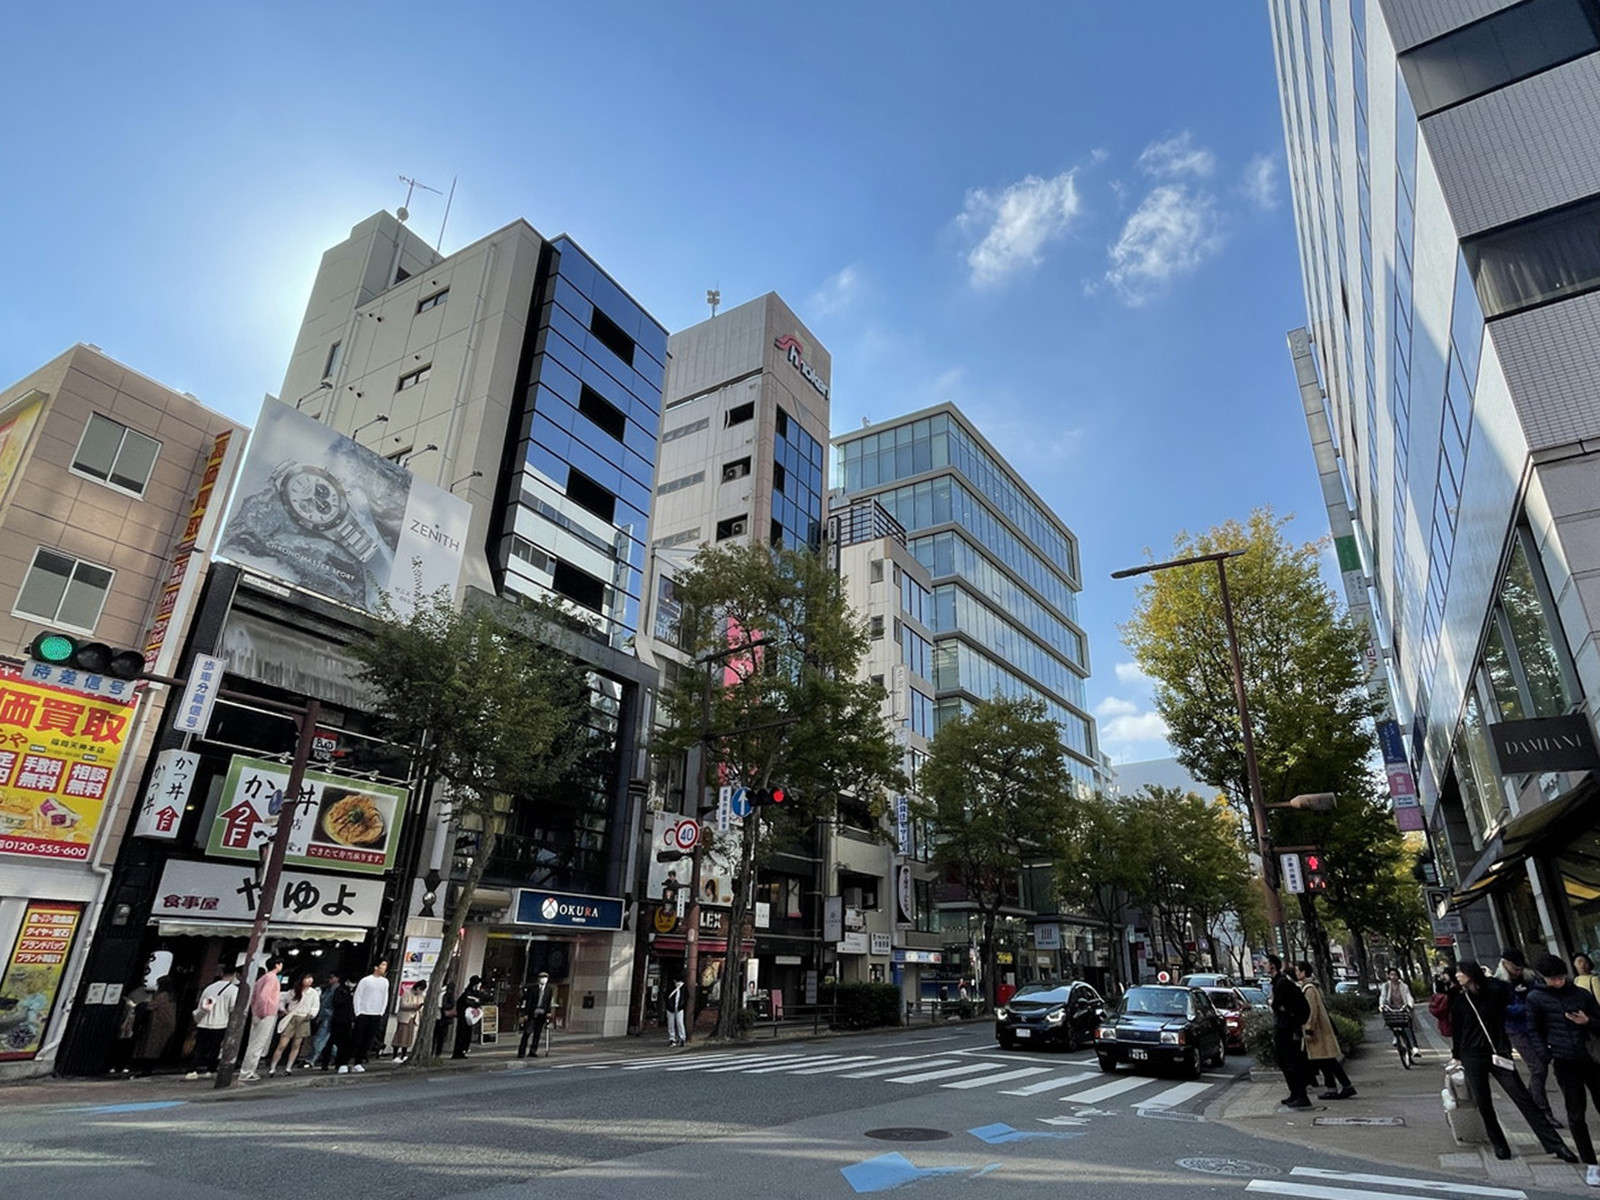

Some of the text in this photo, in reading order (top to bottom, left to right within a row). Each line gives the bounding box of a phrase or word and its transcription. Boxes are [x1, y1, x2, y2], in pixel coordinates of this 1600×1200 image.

[410, 519, 460, 552] ZENITH
[265, 542, 355, 582] CHRONOMASTER SPORT
[32, 663, 126, 695] 時差信号
[187, 660, 215, 728] 歩車分離信号
[0, 688, 128, 745] 価買取
[24, 756, 63, 777] 手数料
[72, 763, 109, 784] 相談
[18, 772, 58, 792] 無料
[66, 779, 104, 798] 無料
[245, 774, 319, 817] か丼
[680, 827, 694, 842] 40
[5, 840, 87, 856] 0120-555-600
[163, 877, 356, 917] 食事屋 やゆよ
[559, 904, 598, 918] OKURA
